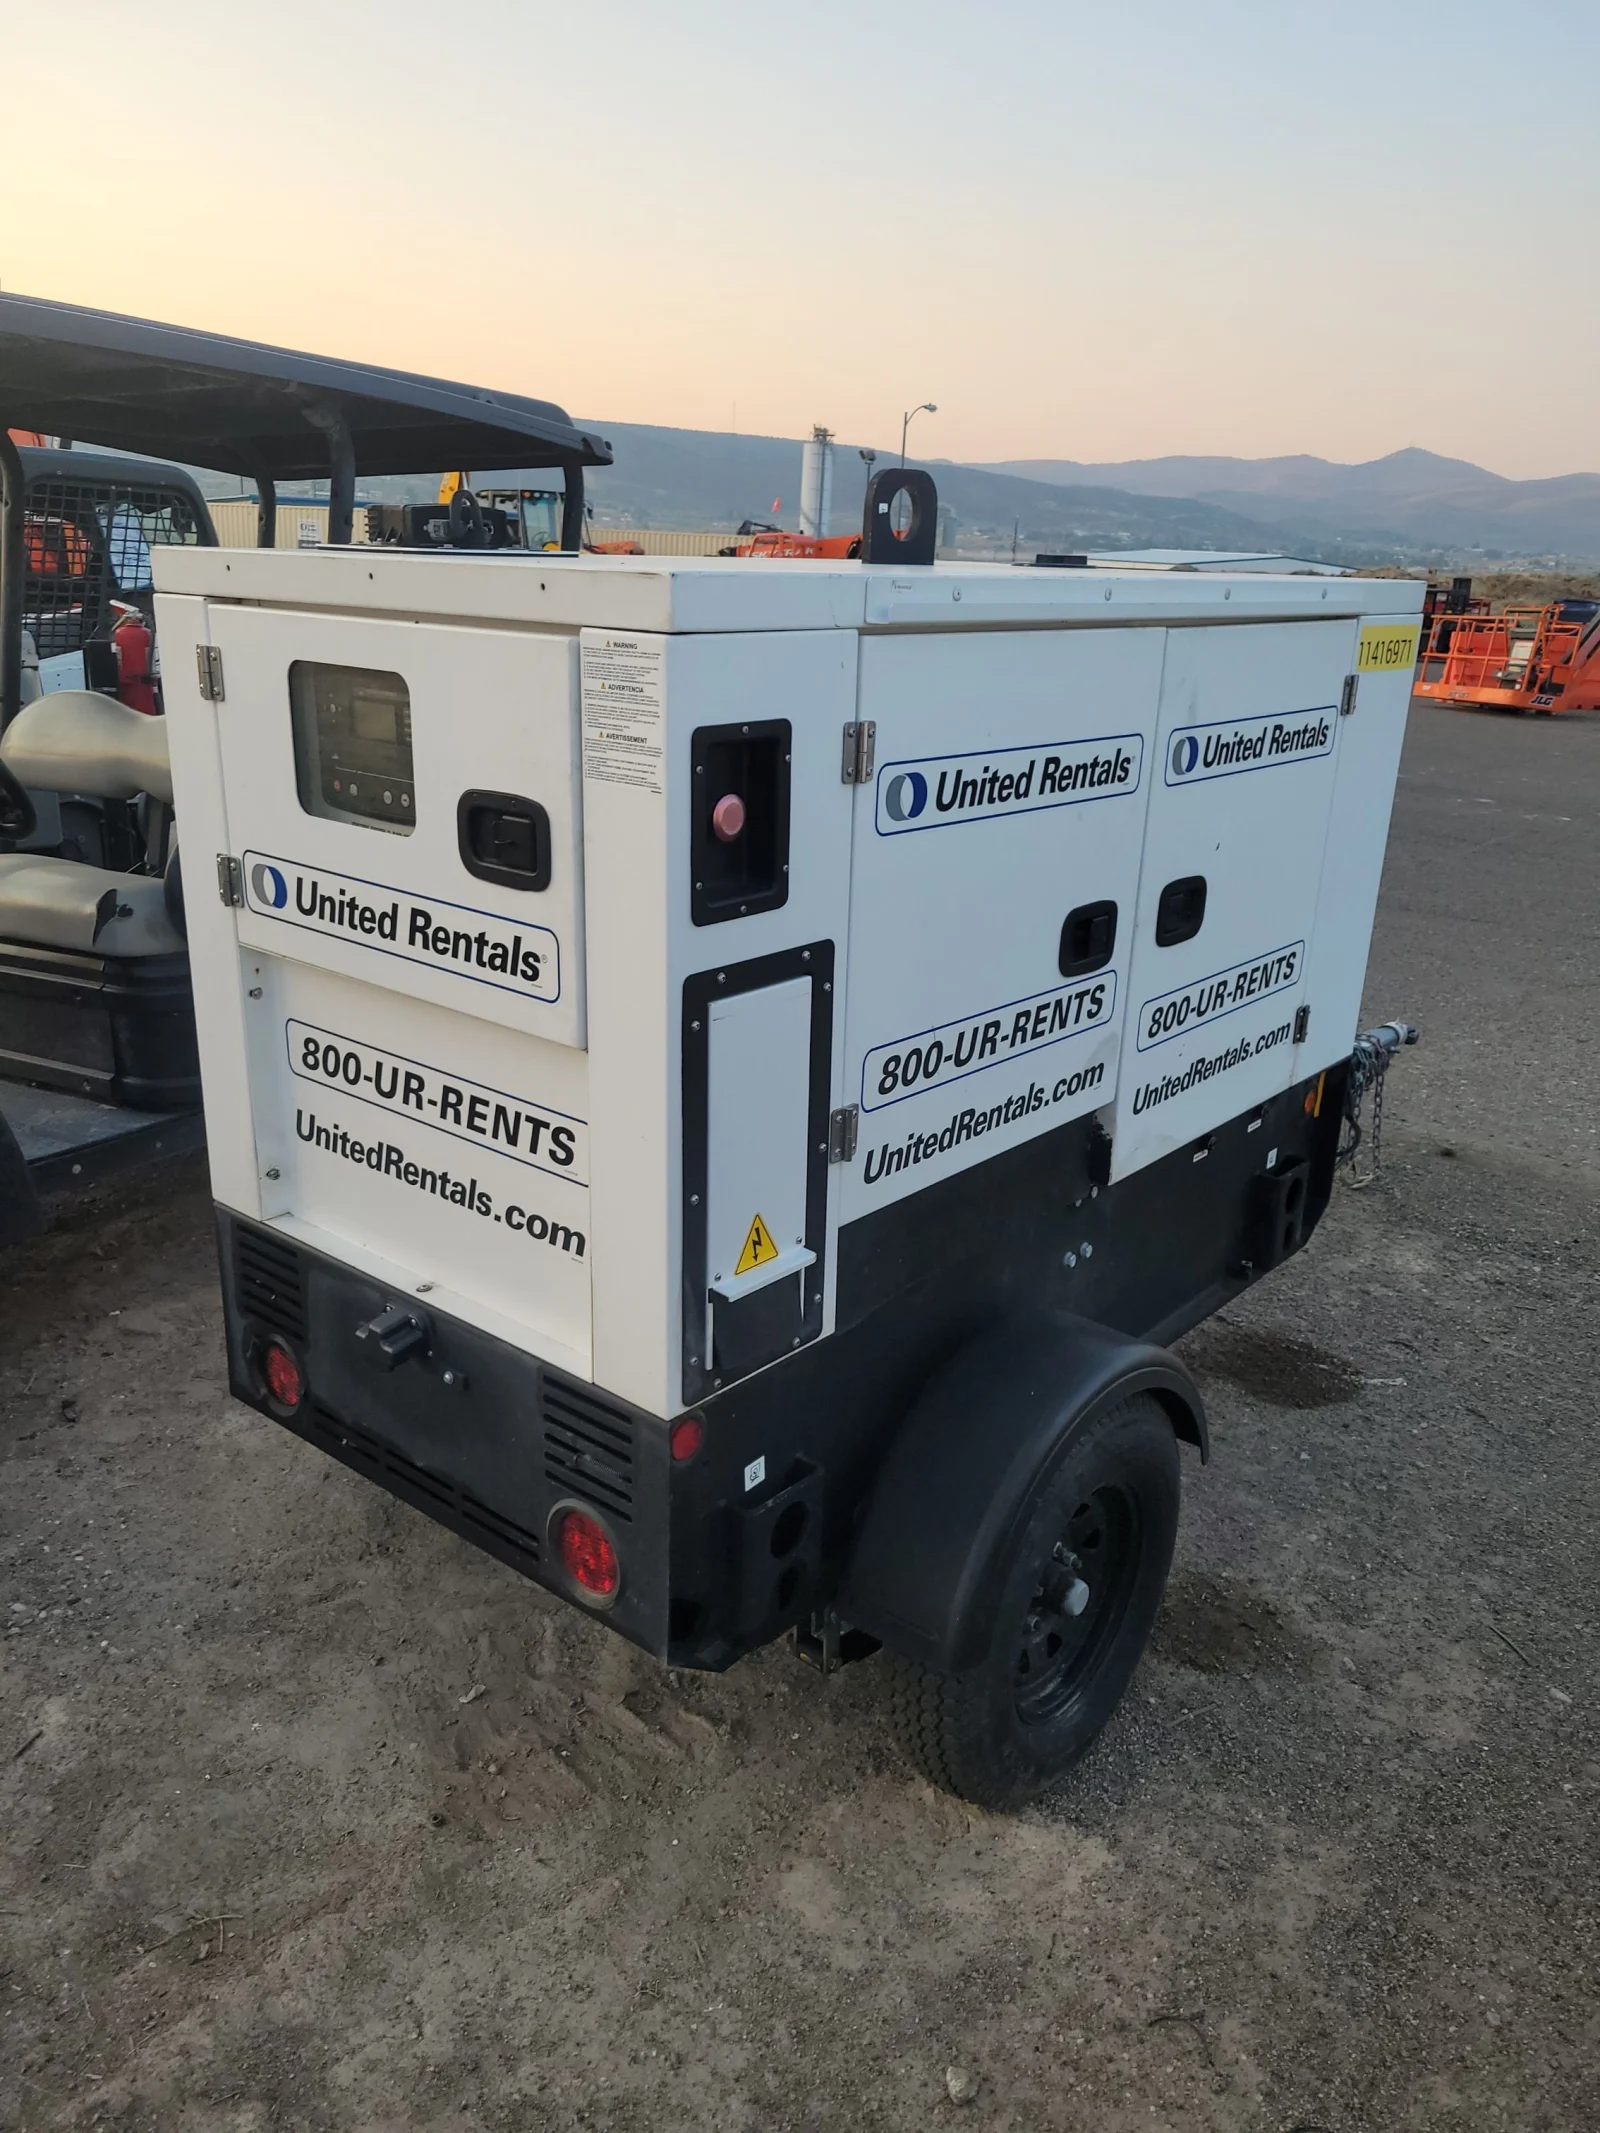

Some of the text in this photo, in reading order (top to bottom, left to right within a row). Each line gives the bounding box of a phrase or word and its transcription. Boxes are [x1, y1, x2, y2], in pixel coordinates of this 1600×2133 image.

[608, 684, 644, 693] ADVERTENCIA
[1358, 639, 1412, 666] 11416971
[606, 733, 647, 744] AVERTISSEMENT
[1203, 718, 1329, 768] United Rentals
[1531, 696, 1553, 705] JLG
[935, 748, 1131, 812] United Rentals
[296, 877, 541, 982] United Rentals
[1148, 951, 1297, 1039] 800-UR-RENTS
[878, 984, 1106, 1095] 800-UR-RENTS
[1133, 1022, 1291, 1115] UnitedRentals.com
[301, 1037, 576, 1167] 800-UR-RENTS
[863, 1062, 1104, 1185] UnitedRentals.com
[296, 1108, 586, 1257] UnitedRentals.com
